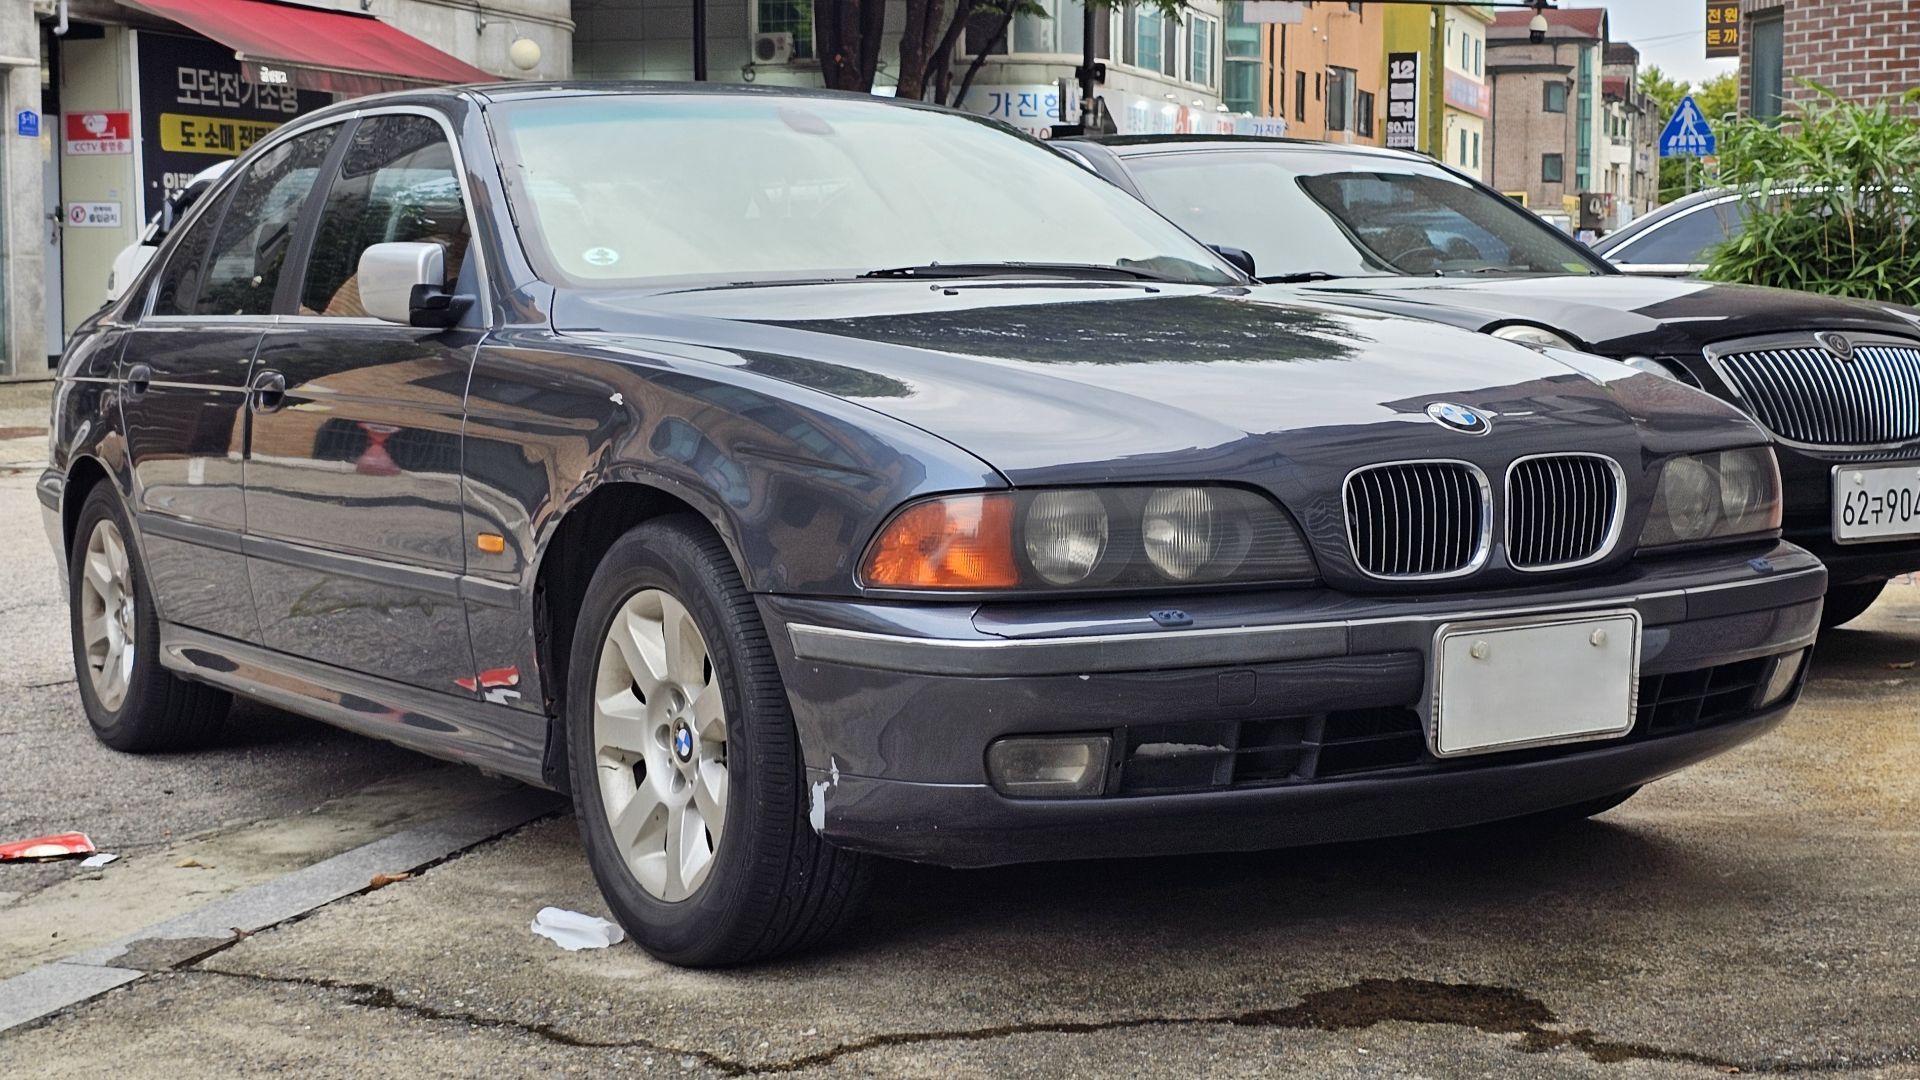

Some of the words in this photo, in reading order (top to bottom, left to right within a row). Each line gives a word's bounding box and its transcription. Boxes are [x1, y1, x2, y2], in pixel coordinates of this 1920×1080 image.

[1708, 7, 1738, 24] 전원
[1390, 60, 1415, 80] 12
[1387, 121, 1415, 133] SOJU
[74, 141, 98, 152] CCTV
[1386, 136, 1414, 148] BEER
